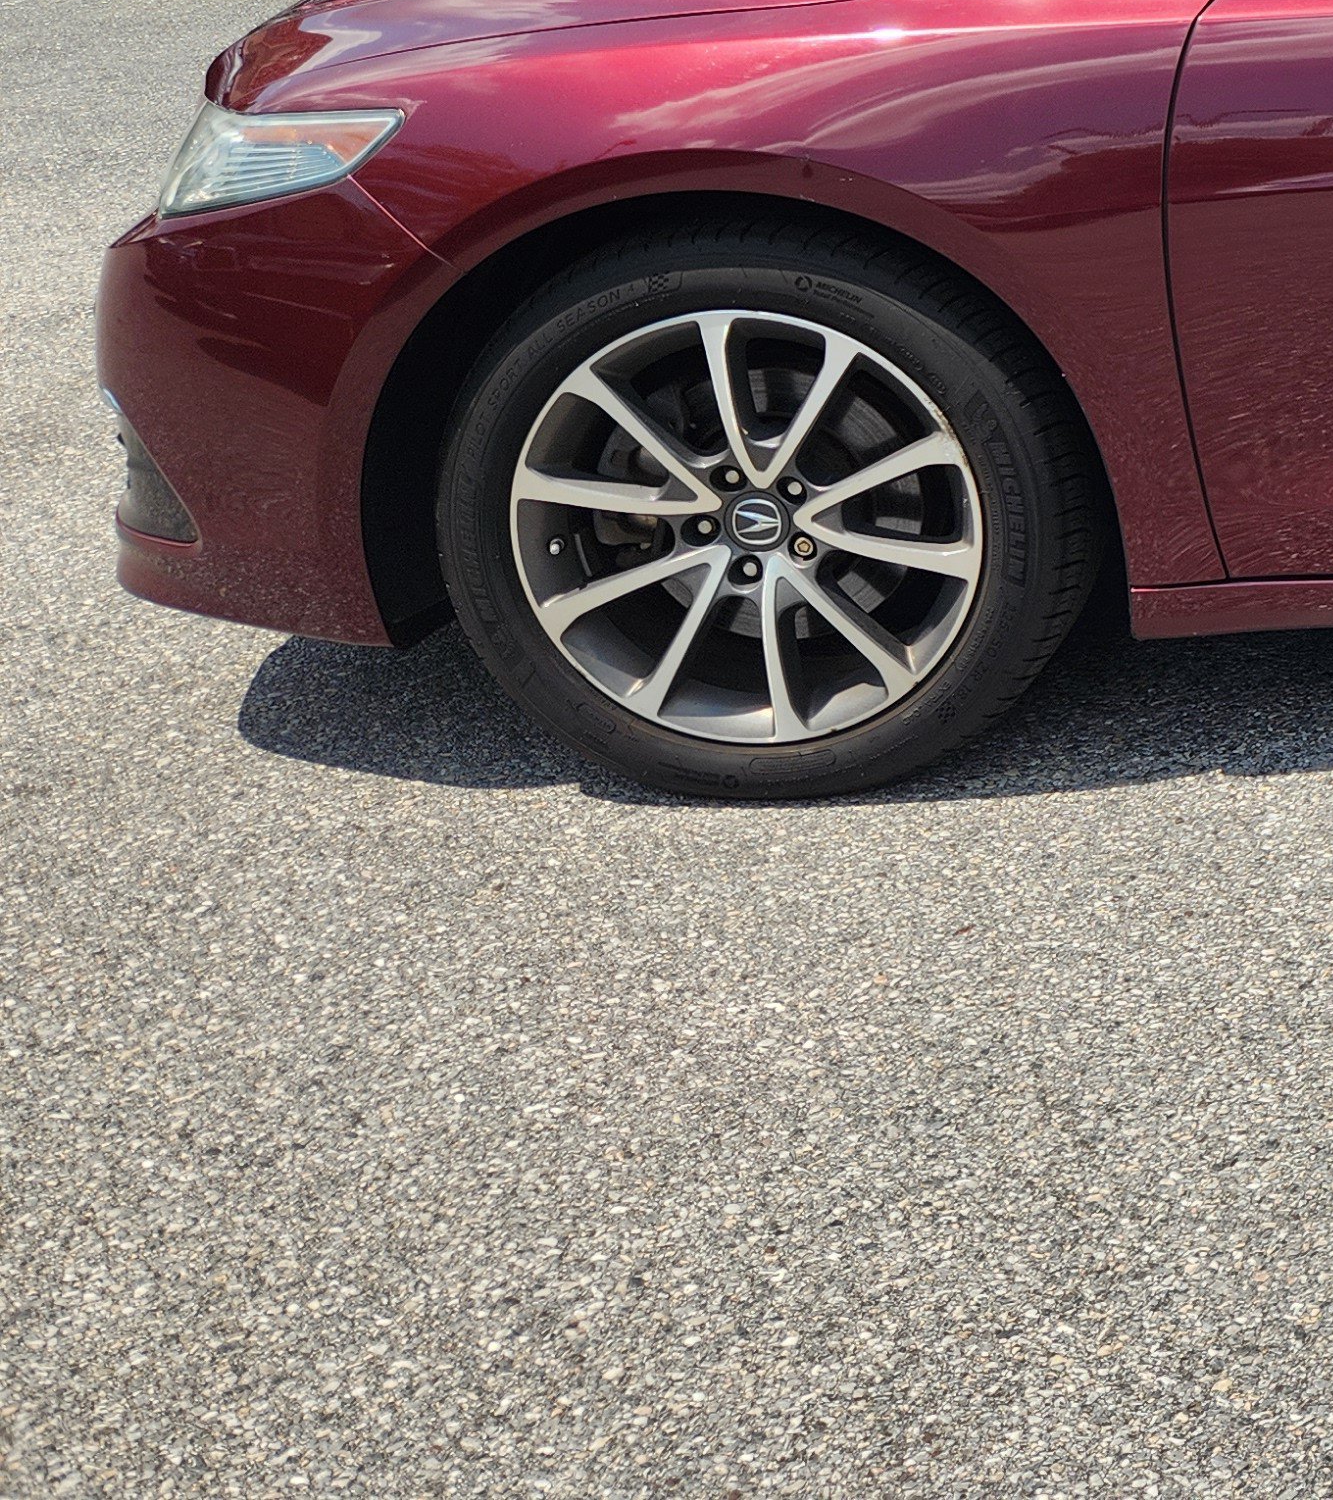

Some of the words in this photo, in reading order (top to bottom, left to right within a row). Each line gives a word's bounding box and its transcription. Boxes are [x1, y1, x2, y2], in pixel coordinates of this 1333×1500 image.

[486, 358, 527, 411] SPORT
[525, 331, 555, 363] ALL
[556, 289, 621, 333] SEASON
[989, 441, 1027, 587] MICHELIN
